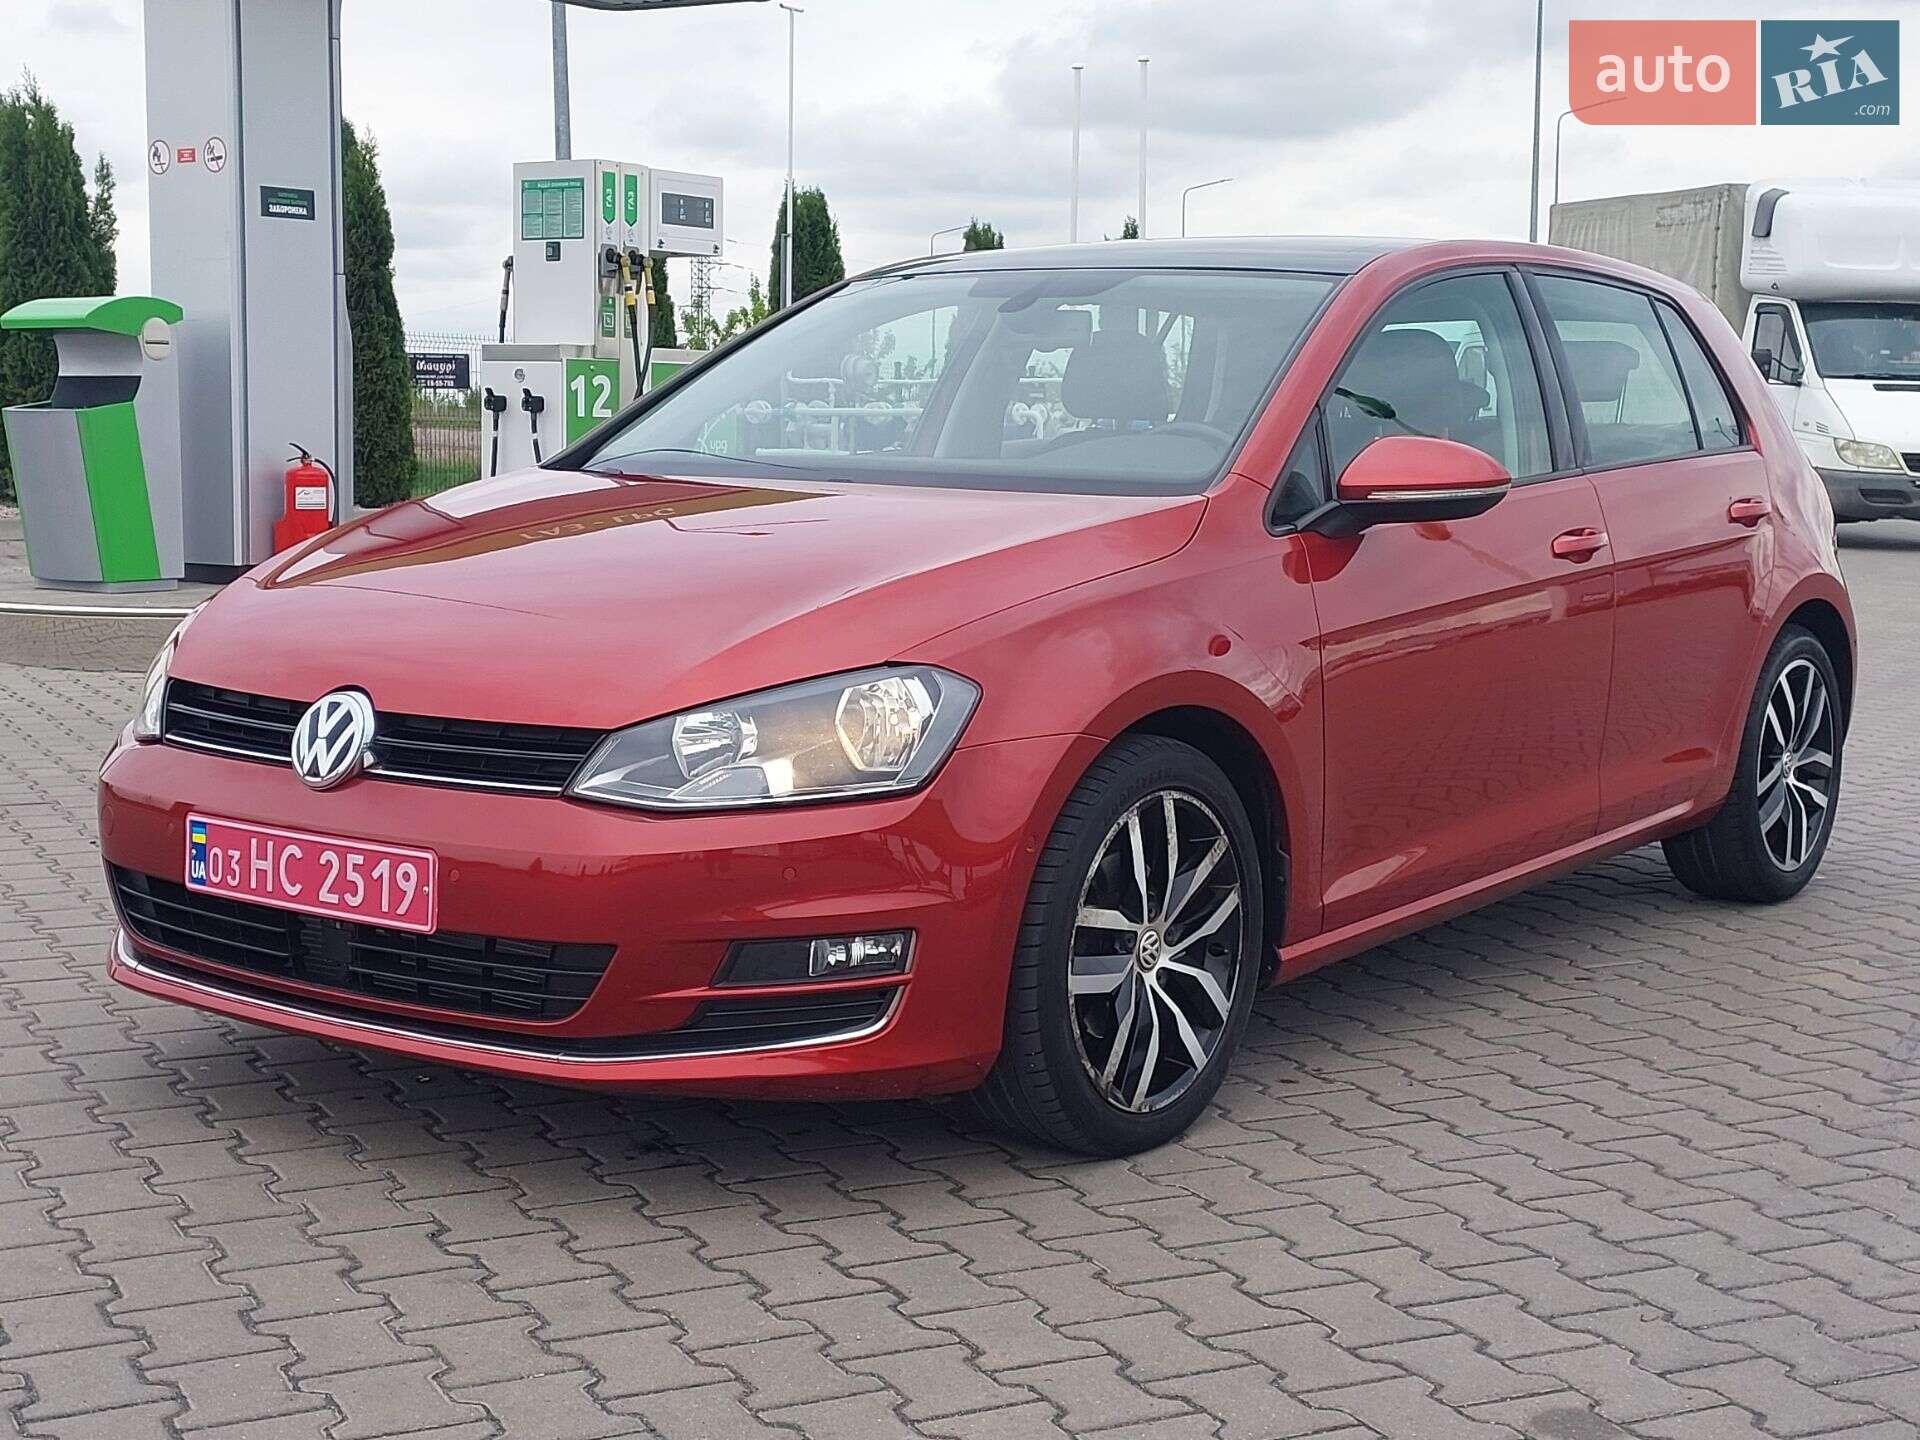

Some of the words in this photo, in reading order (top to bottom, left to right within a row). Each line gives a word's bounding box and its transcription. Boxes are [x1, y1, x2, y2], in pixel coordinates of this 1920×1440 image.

[571, 374, 612, 417] 12
[191, 860, 207, 880] UA
[209, 846, 240, 887] 03
[250, 838, 303, 896] HC
[319, 850, 418, 915] 2519
